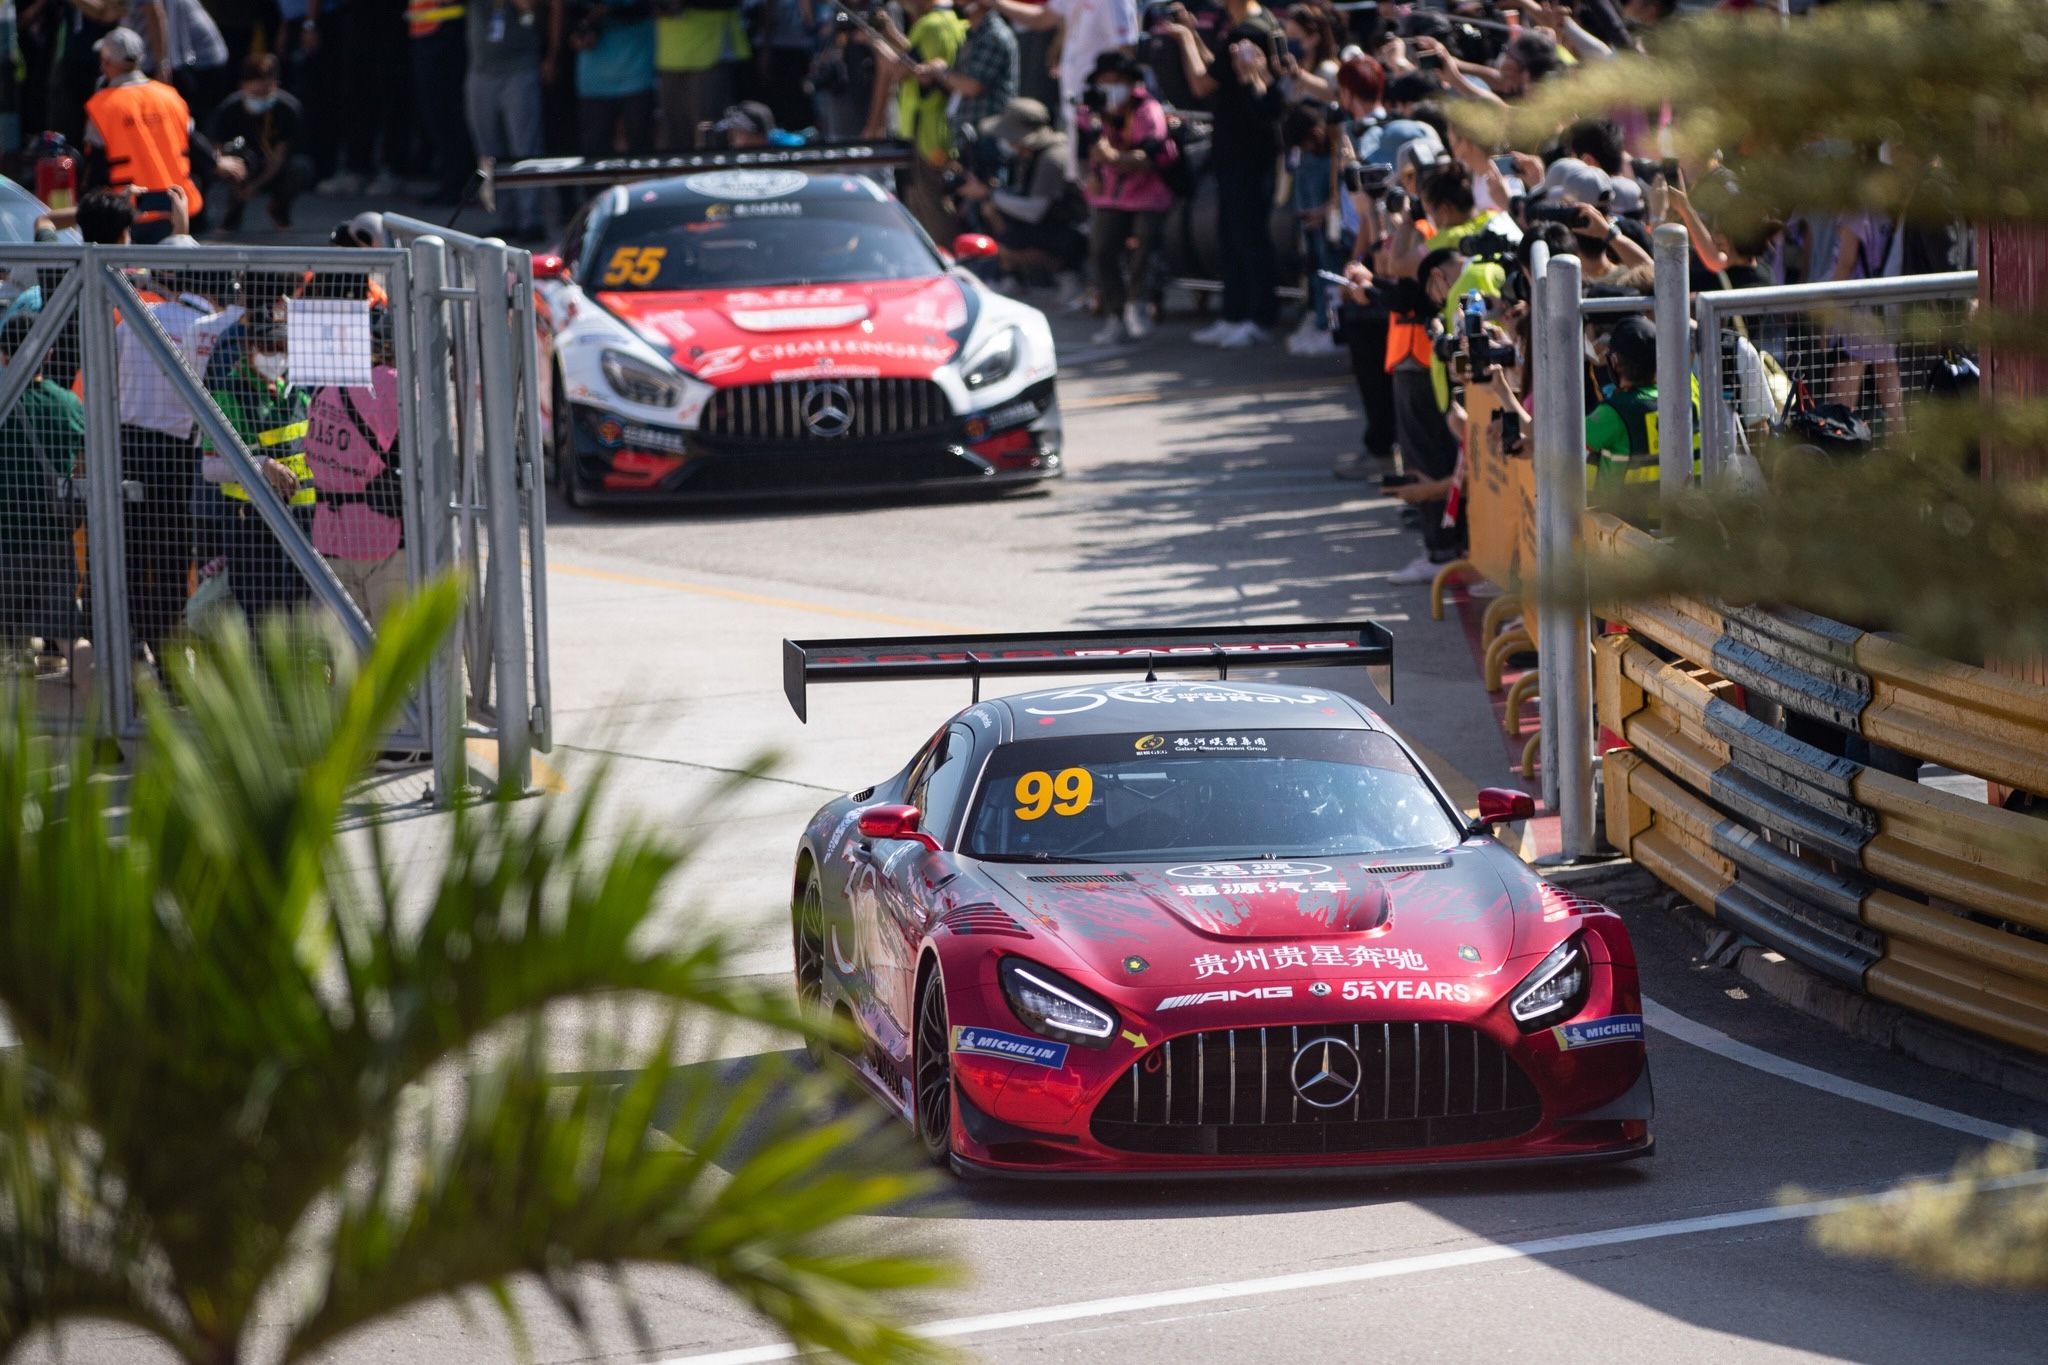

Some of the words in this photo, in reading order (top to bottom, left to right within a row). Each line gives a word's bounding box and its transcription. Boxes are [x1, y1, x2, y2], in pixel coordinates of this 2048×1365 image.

[603, 246, 668, 287] 55
[748, 339, 954, 364] CHALLENGER
[1015, 767, 1094, 822] 99
[1176, 881, 1351, 896] 通源汽车
[1190, 944, 1429, 980] 贵州贵星奔驰
[1196, 986, 1293, 1004] AMG
[1585, 1023, 1641, 1039] MICHELIN
[977, 1035, 1057, 1060] MICHELIN
